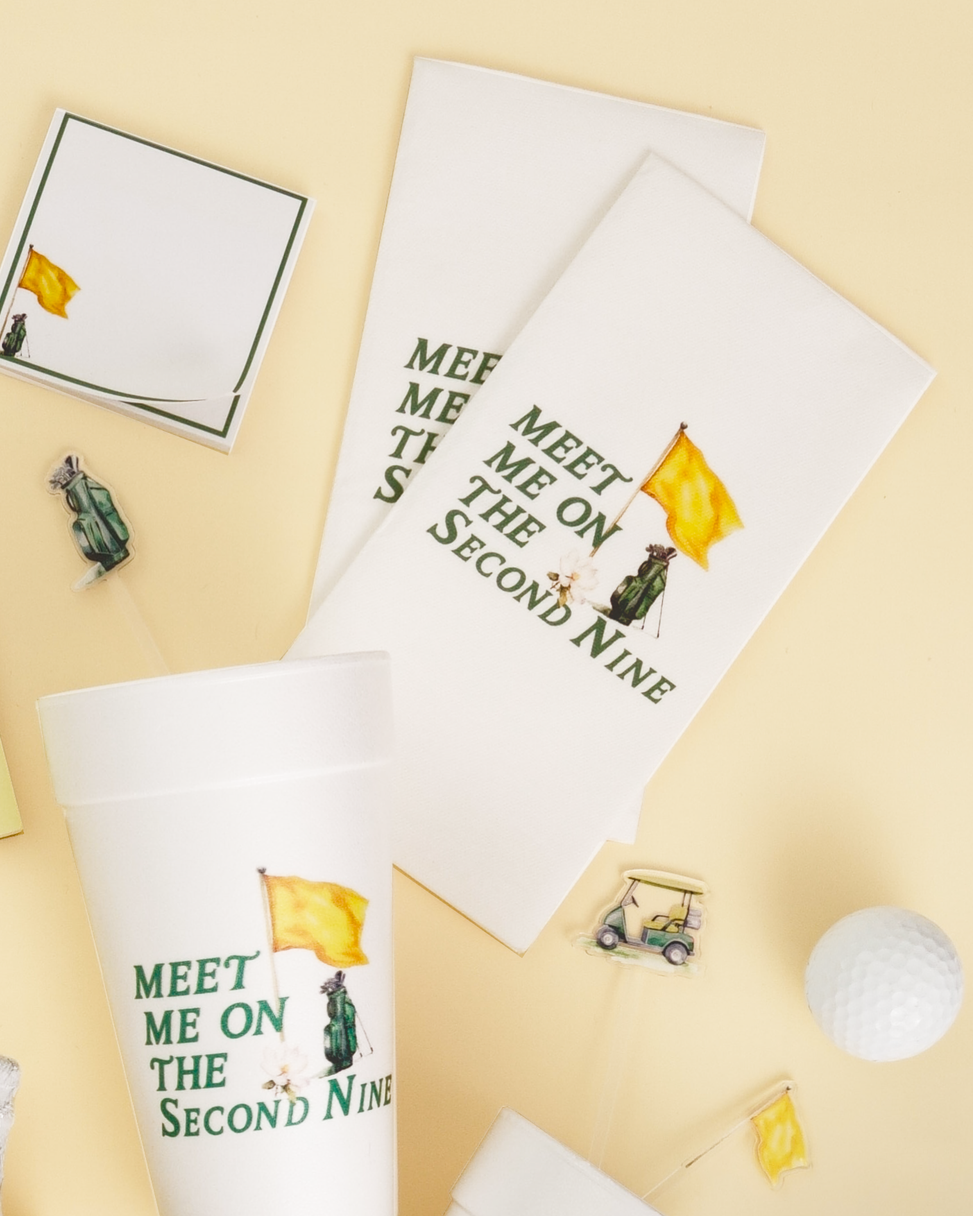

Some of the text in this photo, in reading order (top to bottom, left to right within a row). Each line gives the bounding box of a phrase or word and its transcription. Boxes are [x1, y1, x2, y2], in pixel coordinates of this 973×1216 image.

[403, 337, 503, 385] MEE
[395, 381, 471, 425] ME
[509, 404, 634, 496] MEET
[458, 475, 547, 548] THE
[483, 441, 623, 548] ME ON
[427, 509, 677, 704] SECOND NINE
[133, 950, 261, 999] MEET
[144, 997, 290, 1045] ME ON
[149, 1052, 227, 1091] THE
[160, 1074, 392, 1138] SECOND NINE
